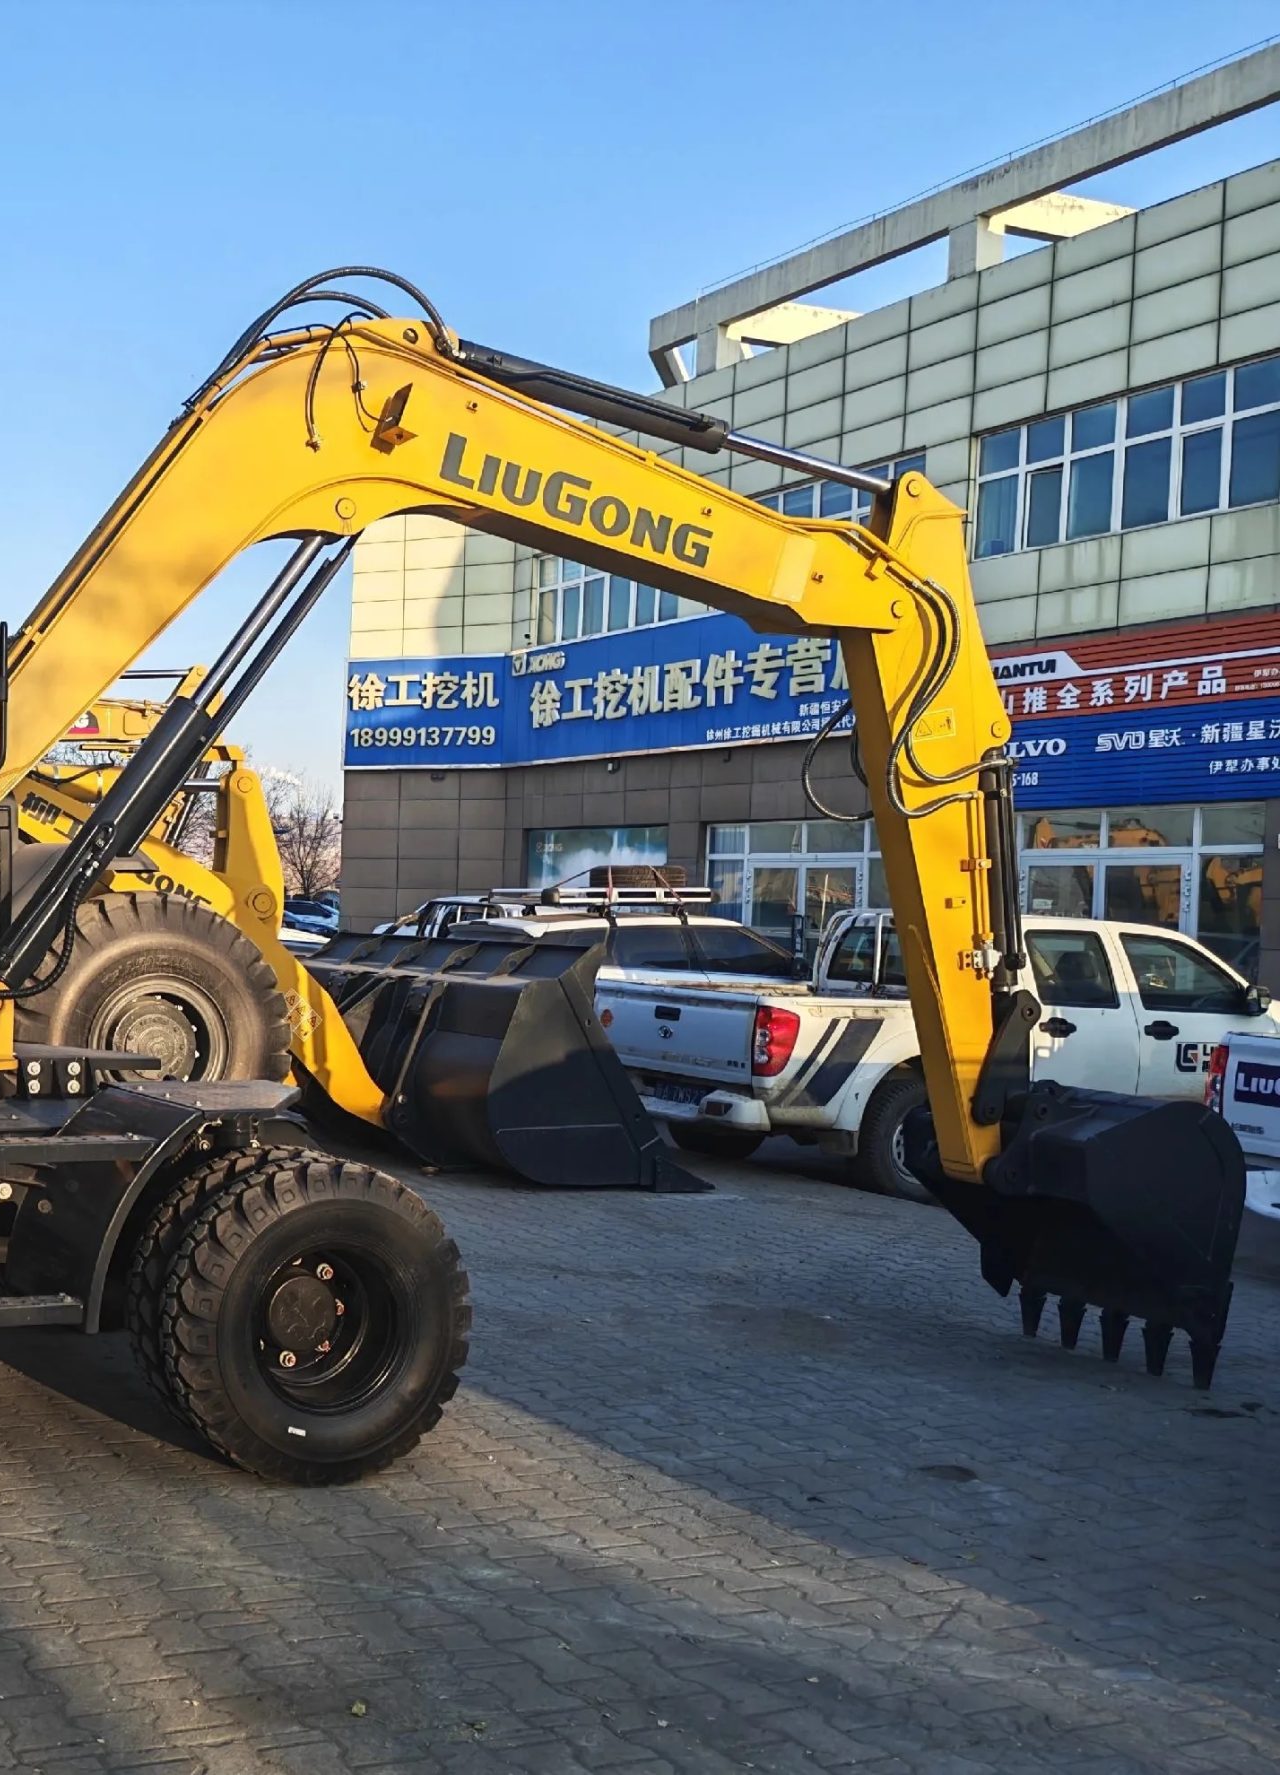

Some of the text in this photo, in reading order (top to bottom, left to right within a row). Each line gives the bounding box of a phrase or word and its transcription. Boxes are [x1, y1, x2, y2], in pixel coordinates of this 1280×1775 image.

[992, 659, 1056, 680] ANTUI
[348, 671, 500, 711] 徐工挖机
[350, 725, 496, 747] 18999137799
[1003, 738, 1067, 758] LVO
